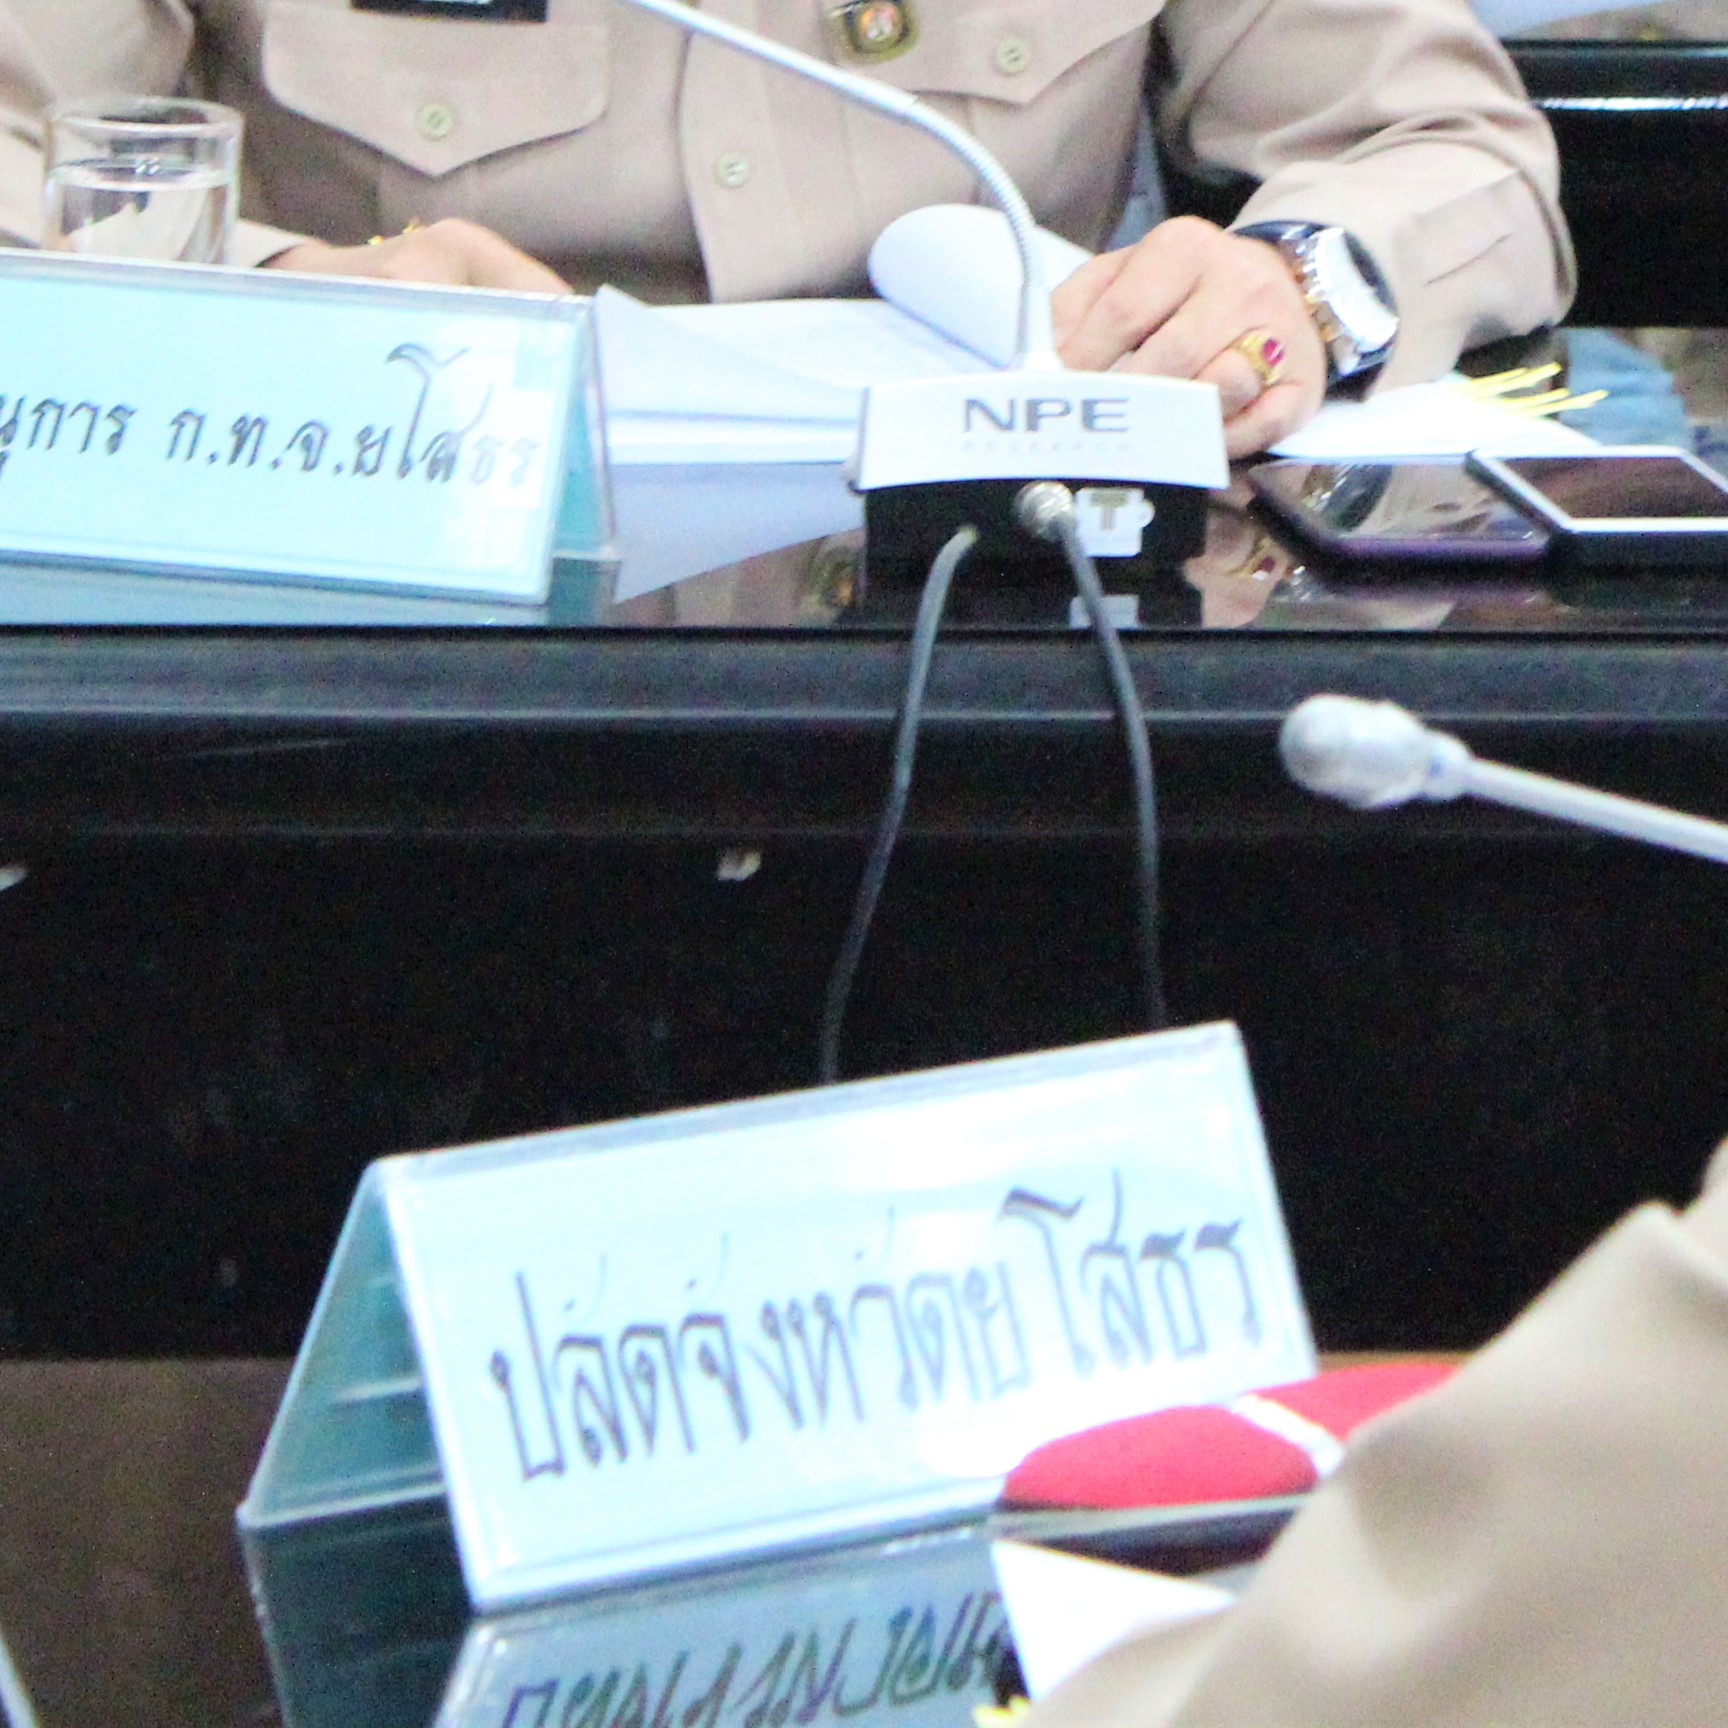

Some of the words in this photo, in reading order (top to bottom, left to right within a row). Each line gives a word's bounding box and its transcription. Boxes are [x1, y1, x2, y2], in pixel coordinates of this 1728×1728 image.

[962, 397, 1132, 433] NPE
[489, 1166, 1264, 1483] ปลัดจังหวัดยโสธร
